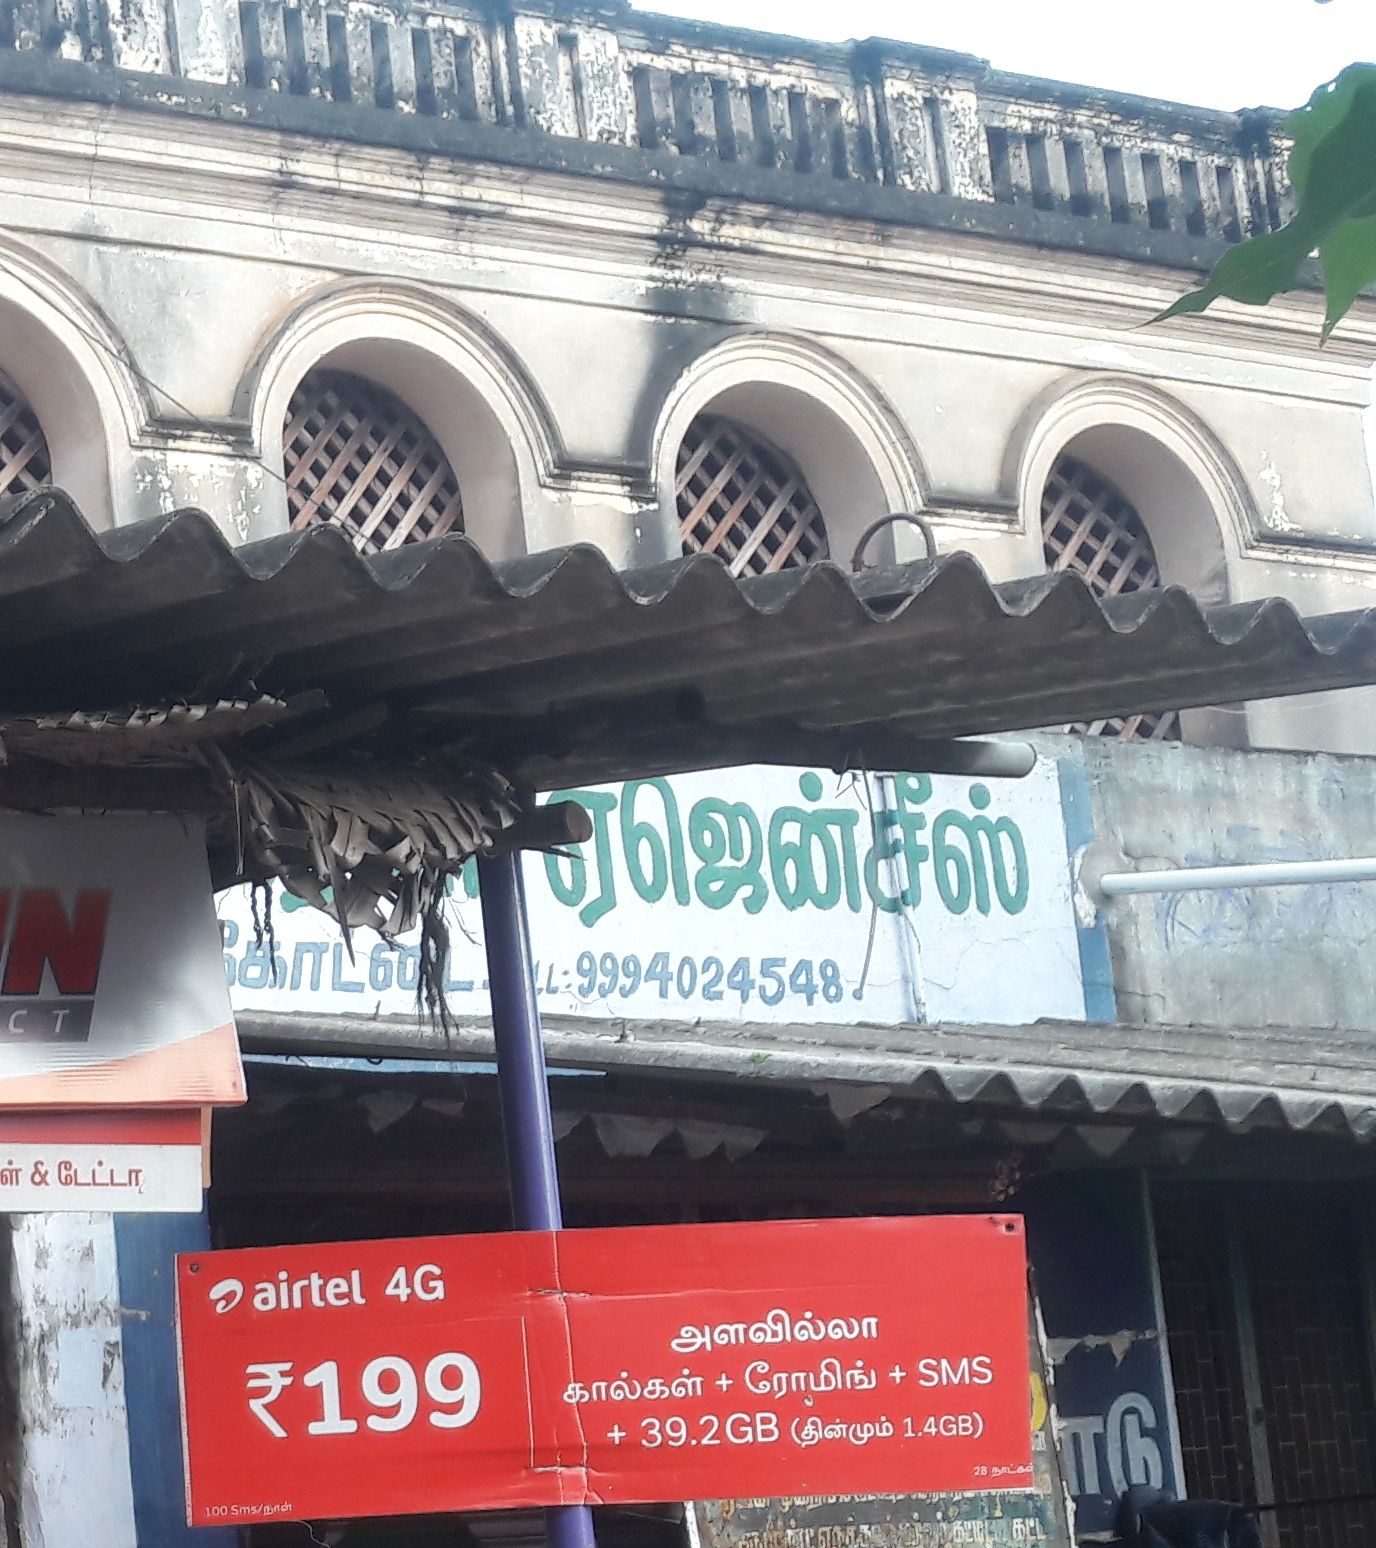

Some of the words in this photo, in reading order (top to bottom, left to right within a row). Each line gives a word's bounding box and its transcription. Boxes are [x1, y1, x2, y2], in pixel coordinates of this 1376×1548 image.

[30, 1161, 50, 1188] &
[253, 1269, 366, 1312] airtel
[384, 1264, 446, 1302] 4G
[671, 1309, 879, 1353] அளவில்லா
[245, 1352, 482, 1438] ₹199
[562, 1367, 704, 1404] கால்கள்
[715, 1374, 733, 1393] +
[744, 1356, 876, 1401] ரோமிங்
[889, 1365, 907, 1384] +
[917, 1355, 994, 1387] SMS
[640, 1412, 779, 1448] 39.2GB
[903, 1411, 985, 1439] 1.4GB)
[205, 1504, 228, 1517] 100
